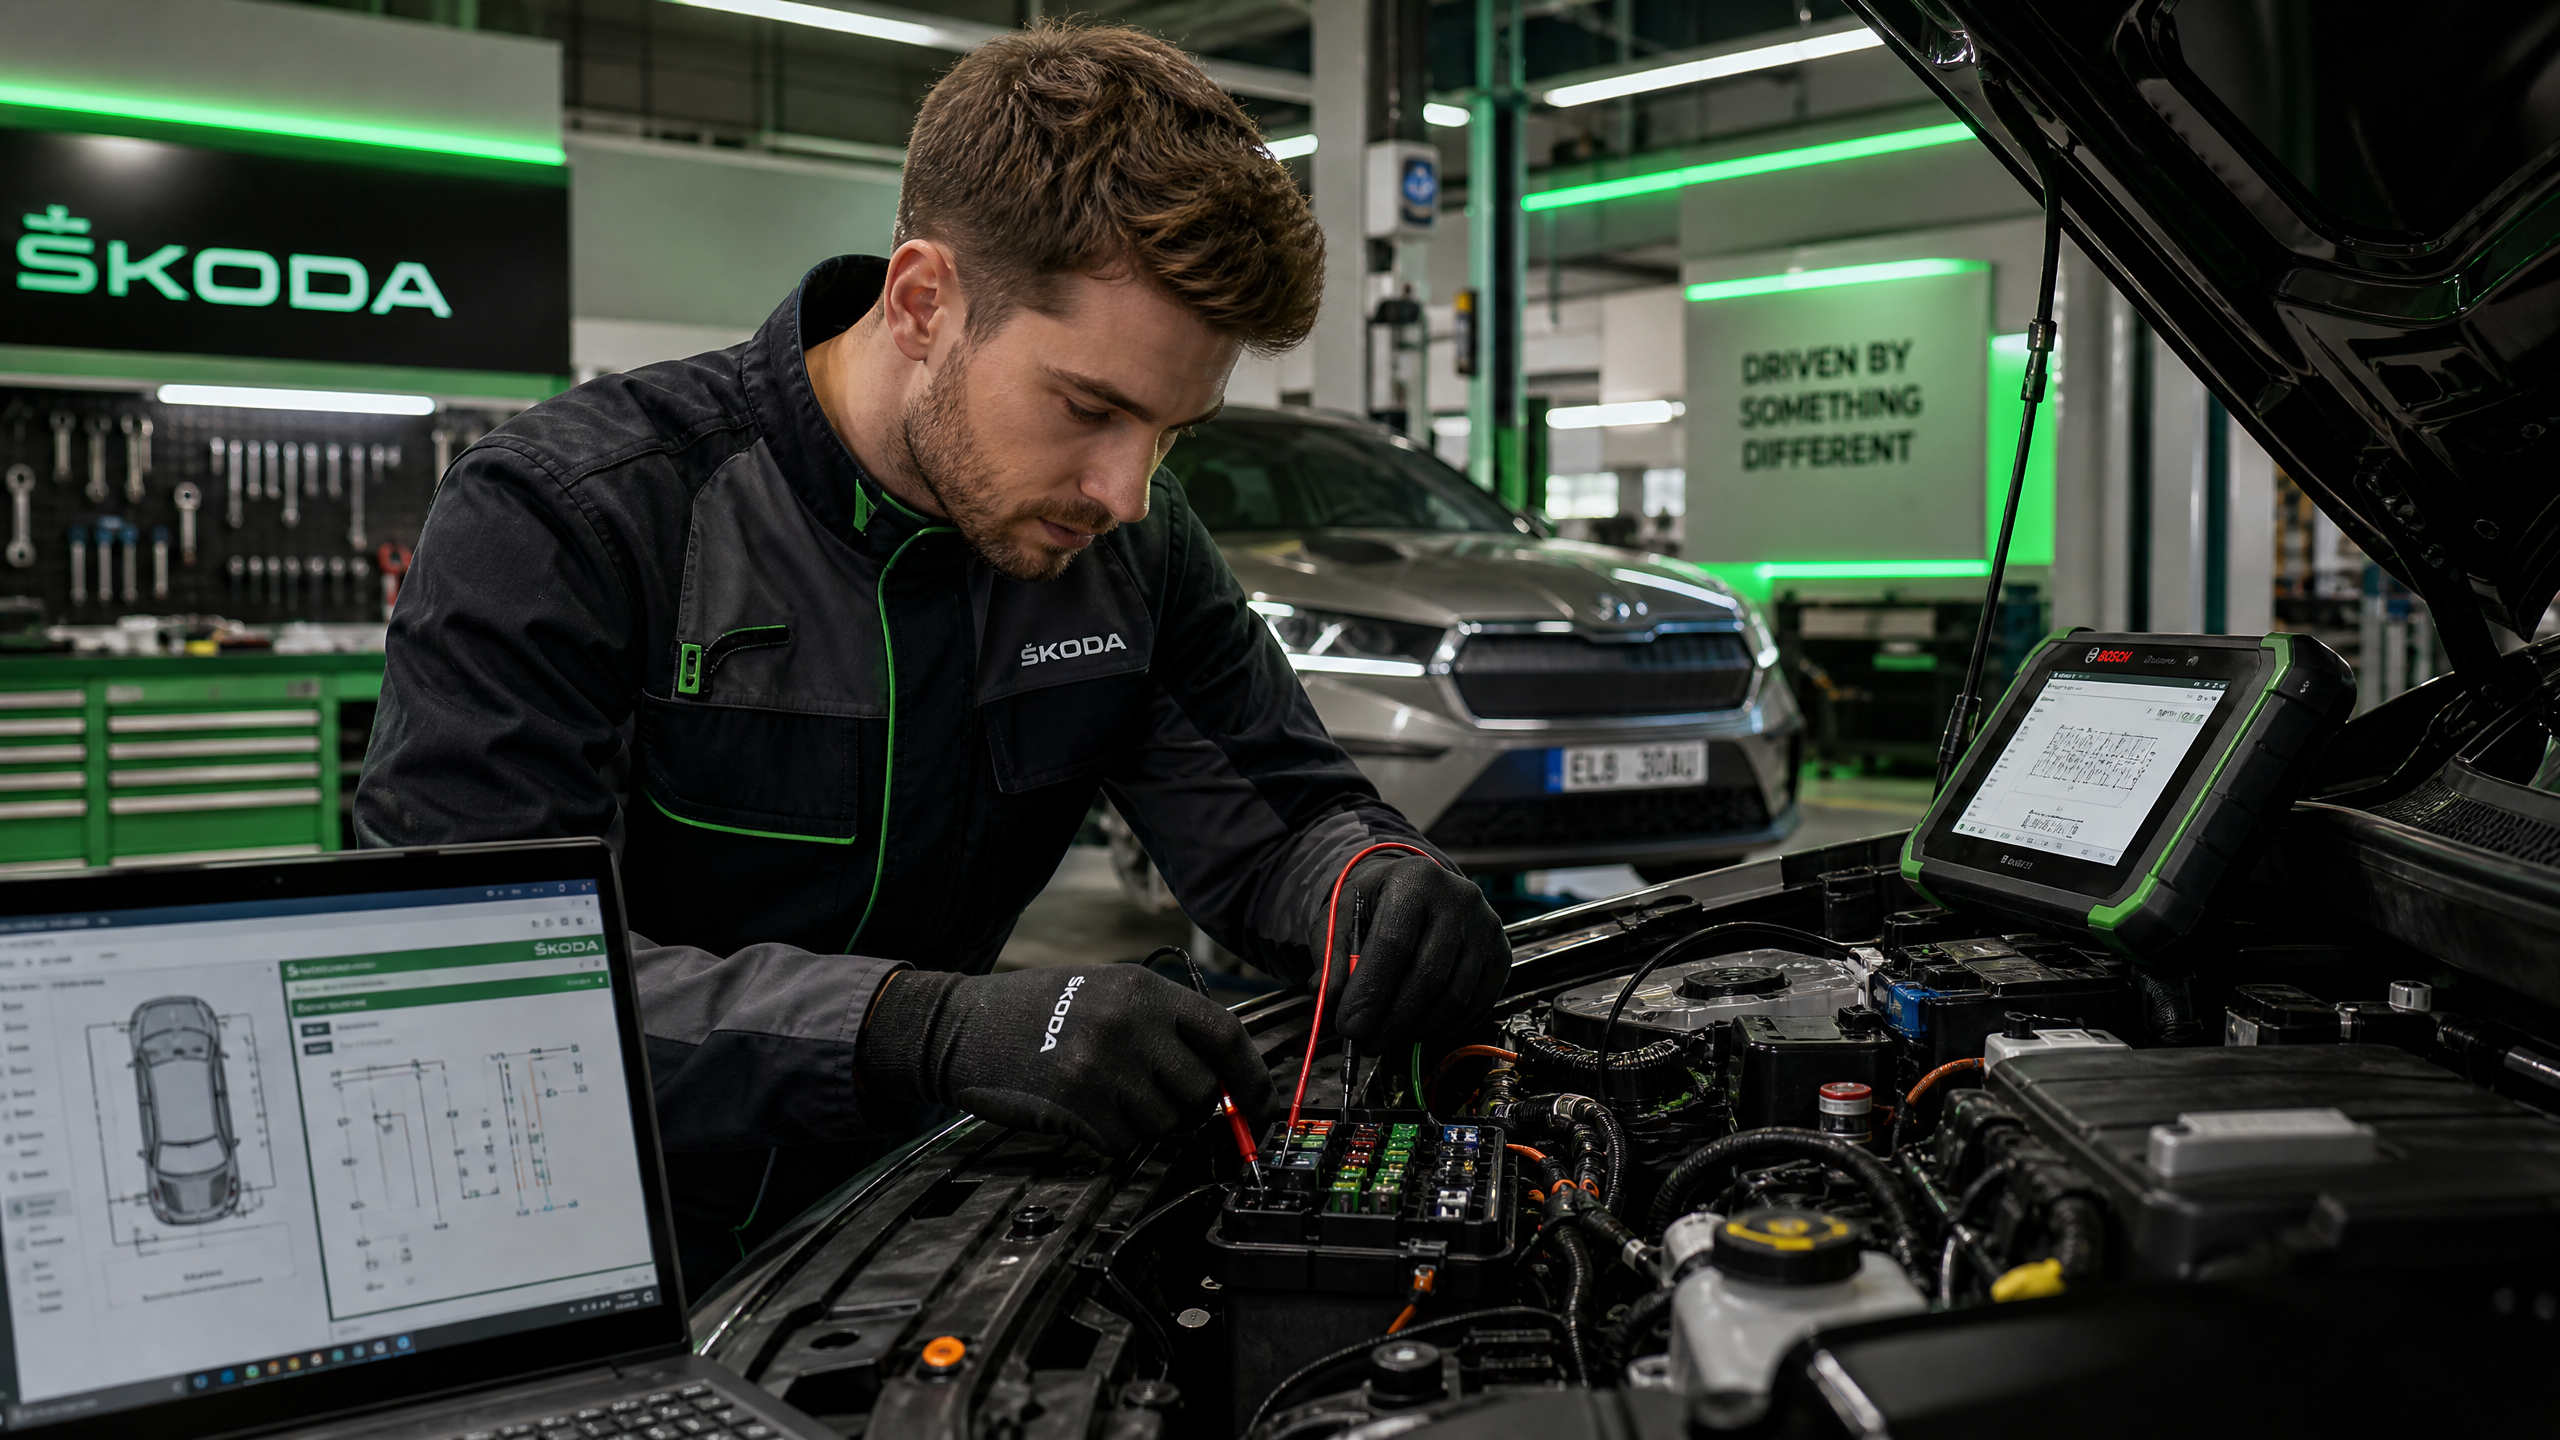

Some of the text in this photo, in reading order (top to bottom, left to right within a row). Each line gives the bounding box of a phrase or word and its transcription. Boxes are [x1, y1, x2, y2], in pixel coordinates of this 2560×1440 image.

[15, 204, 453, 319] ŠKODA
[1742, 339, 1914, 386] DRIVEN BY
[1739, 384, 1924, 429] SOMETHING
[1742, 430, 1916, 472] DIFFERENT
[1021, 633, 1127, 667] ŠKODA
[2097, 650, 2134, 663] BOSCH
[534, 940, 599, 956] ŠKODA
[1040, 975, 1085, 1053] ŠKODA
